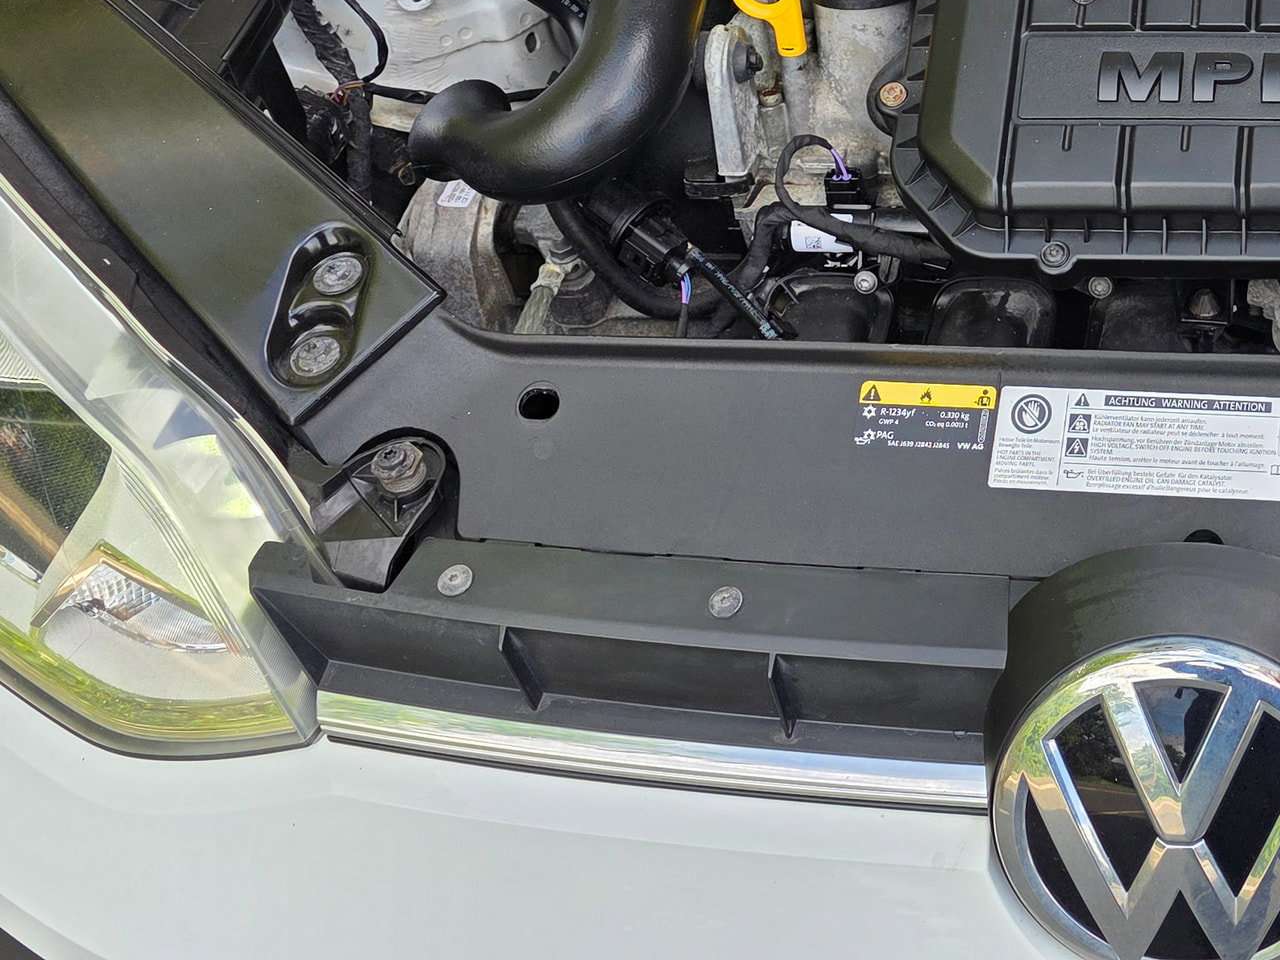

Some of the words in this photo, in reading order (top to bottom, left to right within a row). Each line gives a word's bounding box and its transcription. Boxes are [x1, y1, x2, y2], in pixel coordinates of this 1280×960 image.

[1108, 396, 1155, 407] ACHTUNG
[1161, 398, 1208, 410] WARNING
[1213, 400, 1266, 412] ATTENTION
[880, 407, 916, 419] R-1234yf
[960, 412, 970, 421] kg
[876, 430, 894, 440] PAG
[957, 442, 971, 450] VW
[971, 443, 985, 451] AG
